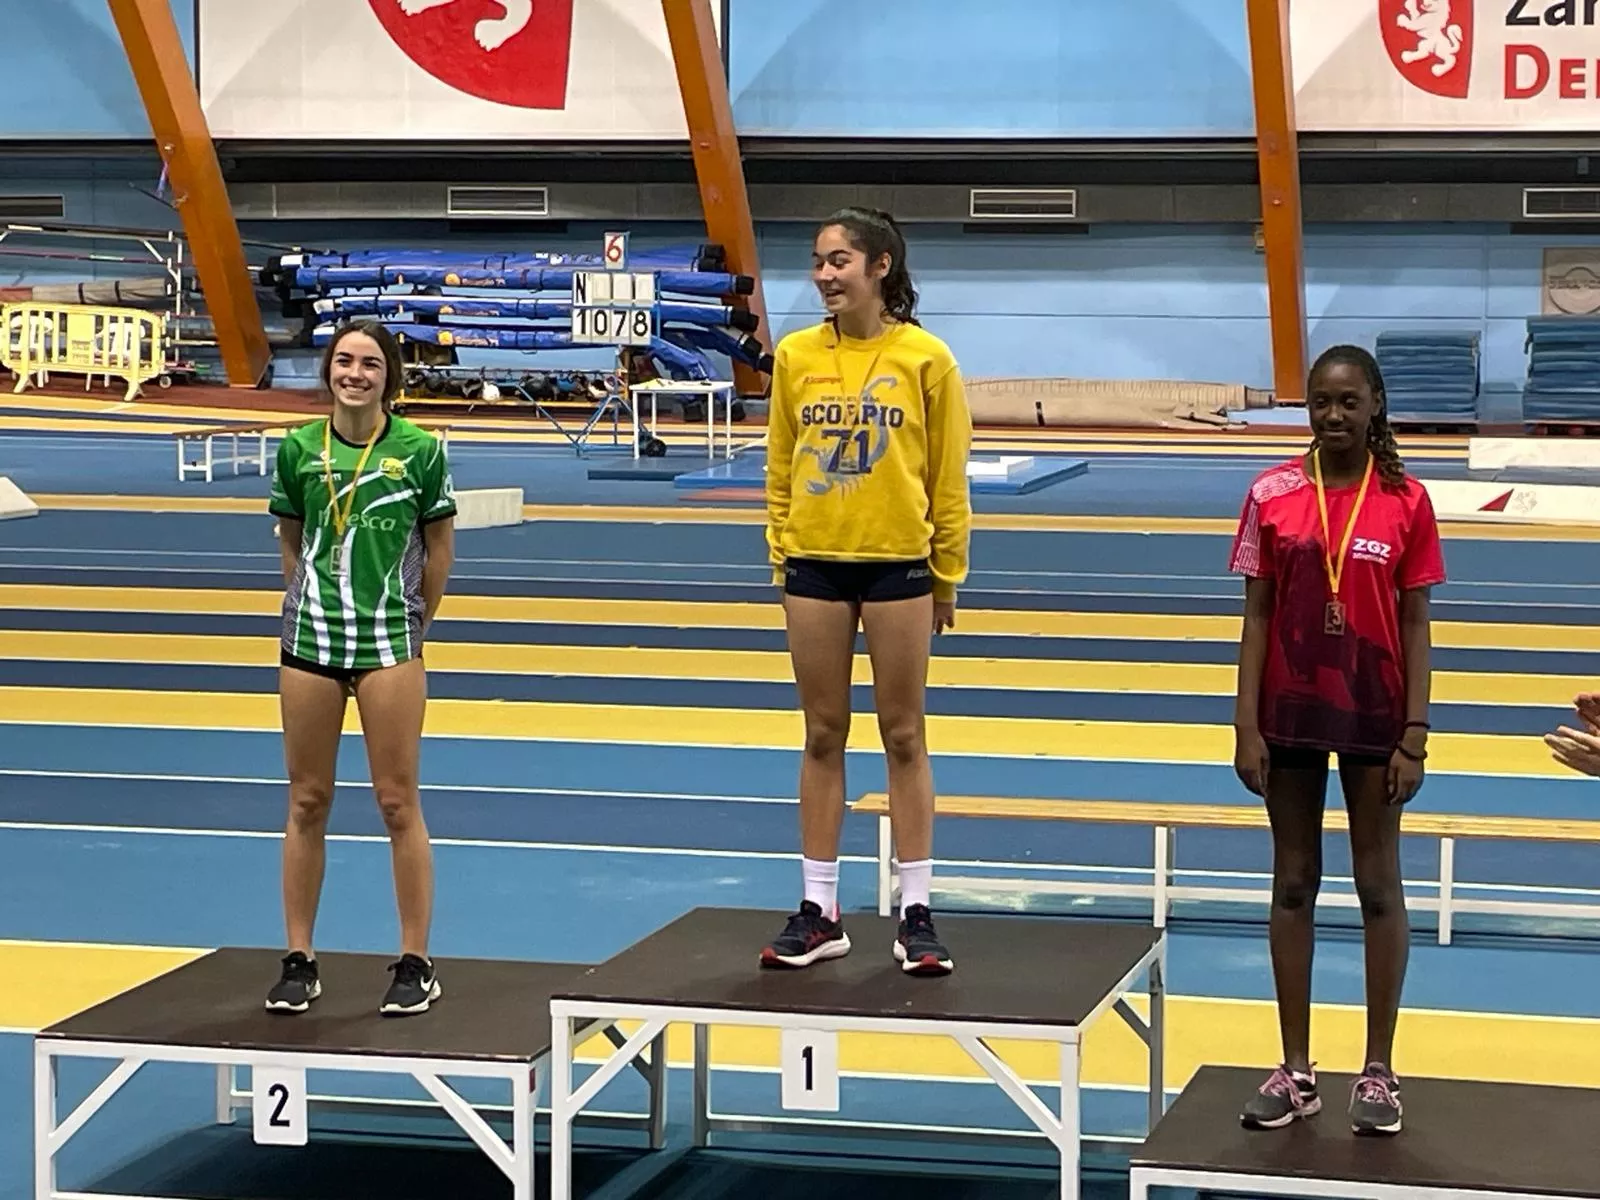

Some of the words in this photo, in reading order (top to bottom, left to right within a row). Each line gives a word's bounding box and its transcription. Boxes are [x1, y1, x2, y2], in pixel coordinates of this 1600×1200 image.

[1504, 44, 1600, 99] DE
[606, 234, 622, 263] 6
[576, 309, 649, 337] 1078
[820, 428, 872, 475] 71
[317, 509, 397, 532] Hesca
[1352, 537, 1392, 559] ZGZ
[802, 1045, 814, 1091] 1
[268, 1083, 291, 1127] 2
